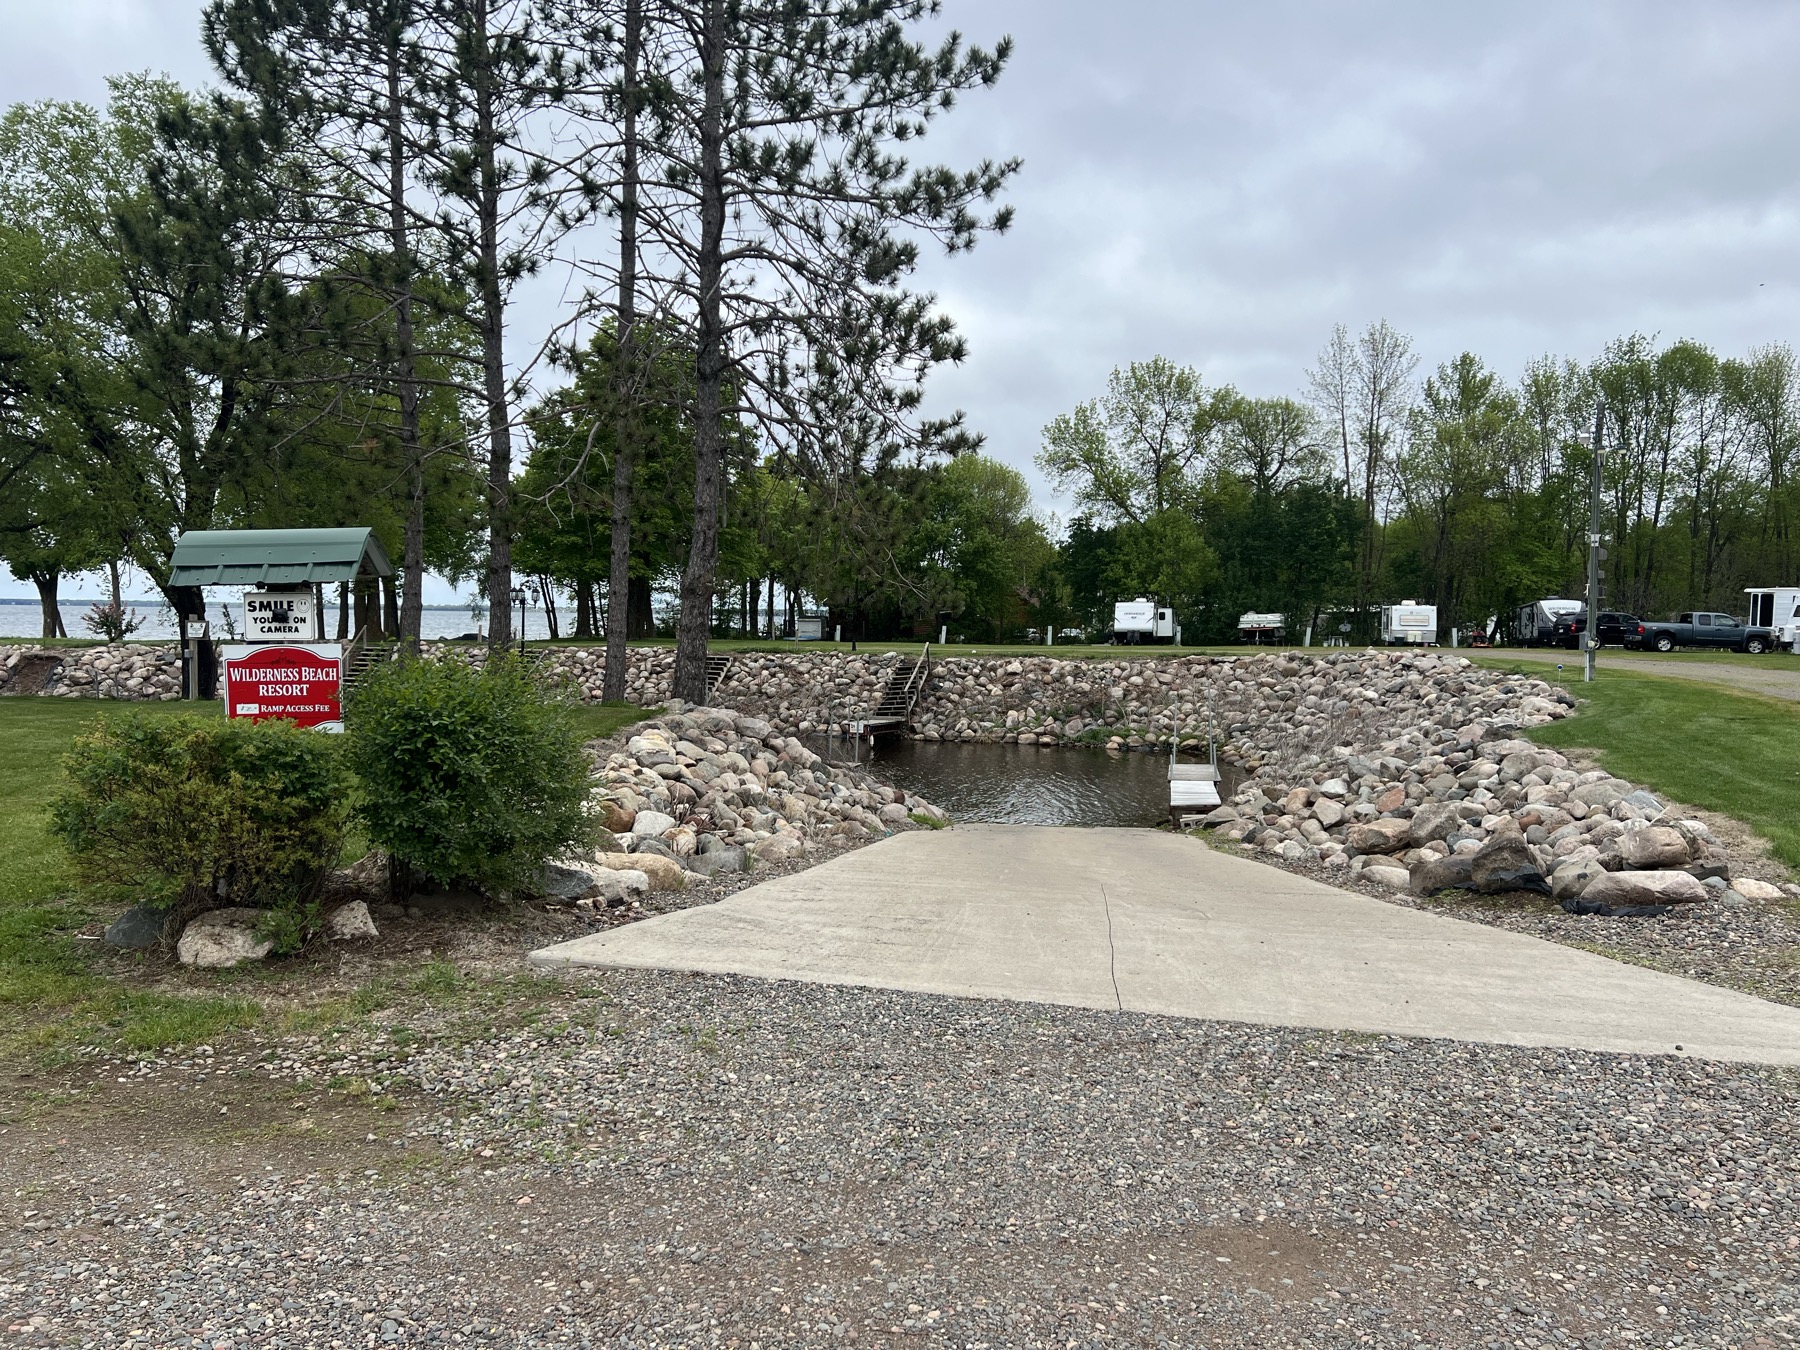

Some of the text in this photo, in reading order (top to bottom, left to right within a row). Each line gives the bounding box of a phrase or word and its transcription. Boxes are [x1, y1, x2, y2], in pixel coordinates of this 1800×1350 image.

[248, 600, 294, 612] SMILE
[293, 616, 306, 624] ON
[229, 667, 337, 681] WILDERNESS BEACH
[259, 684, 309, 696] RESORT
[285, 704, 314, 712] ACCESS
[315, 704, 330, 712] FEE
